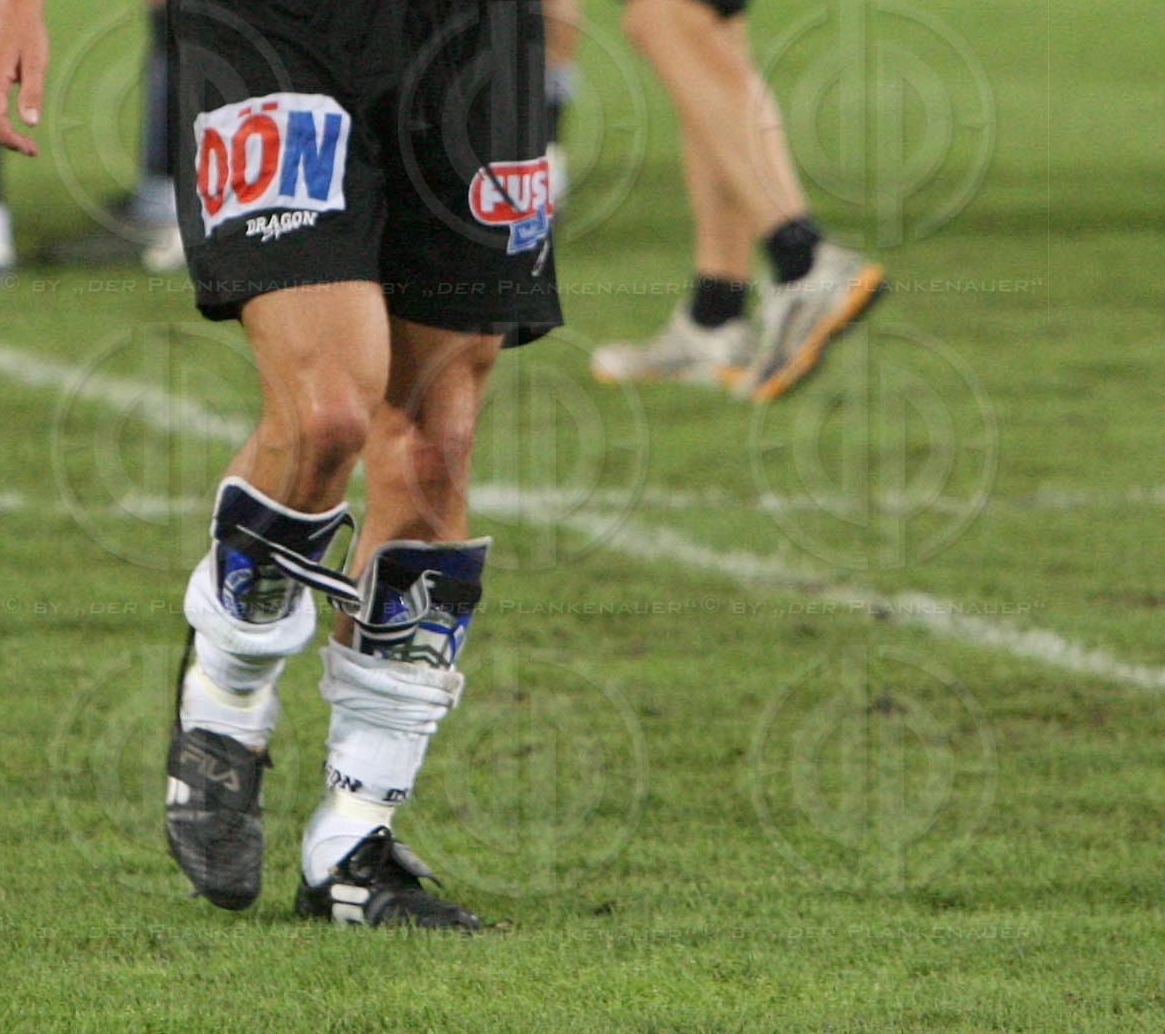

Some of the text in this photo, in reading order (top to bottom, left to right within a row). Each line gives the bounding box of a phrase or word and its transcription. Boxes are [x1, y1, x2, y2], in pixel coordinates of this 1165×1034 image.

[198, 101, 342, 216] OÖN
[246, 211, 318, 236] DRAGON
[180, 744, 241, 791] FILA
